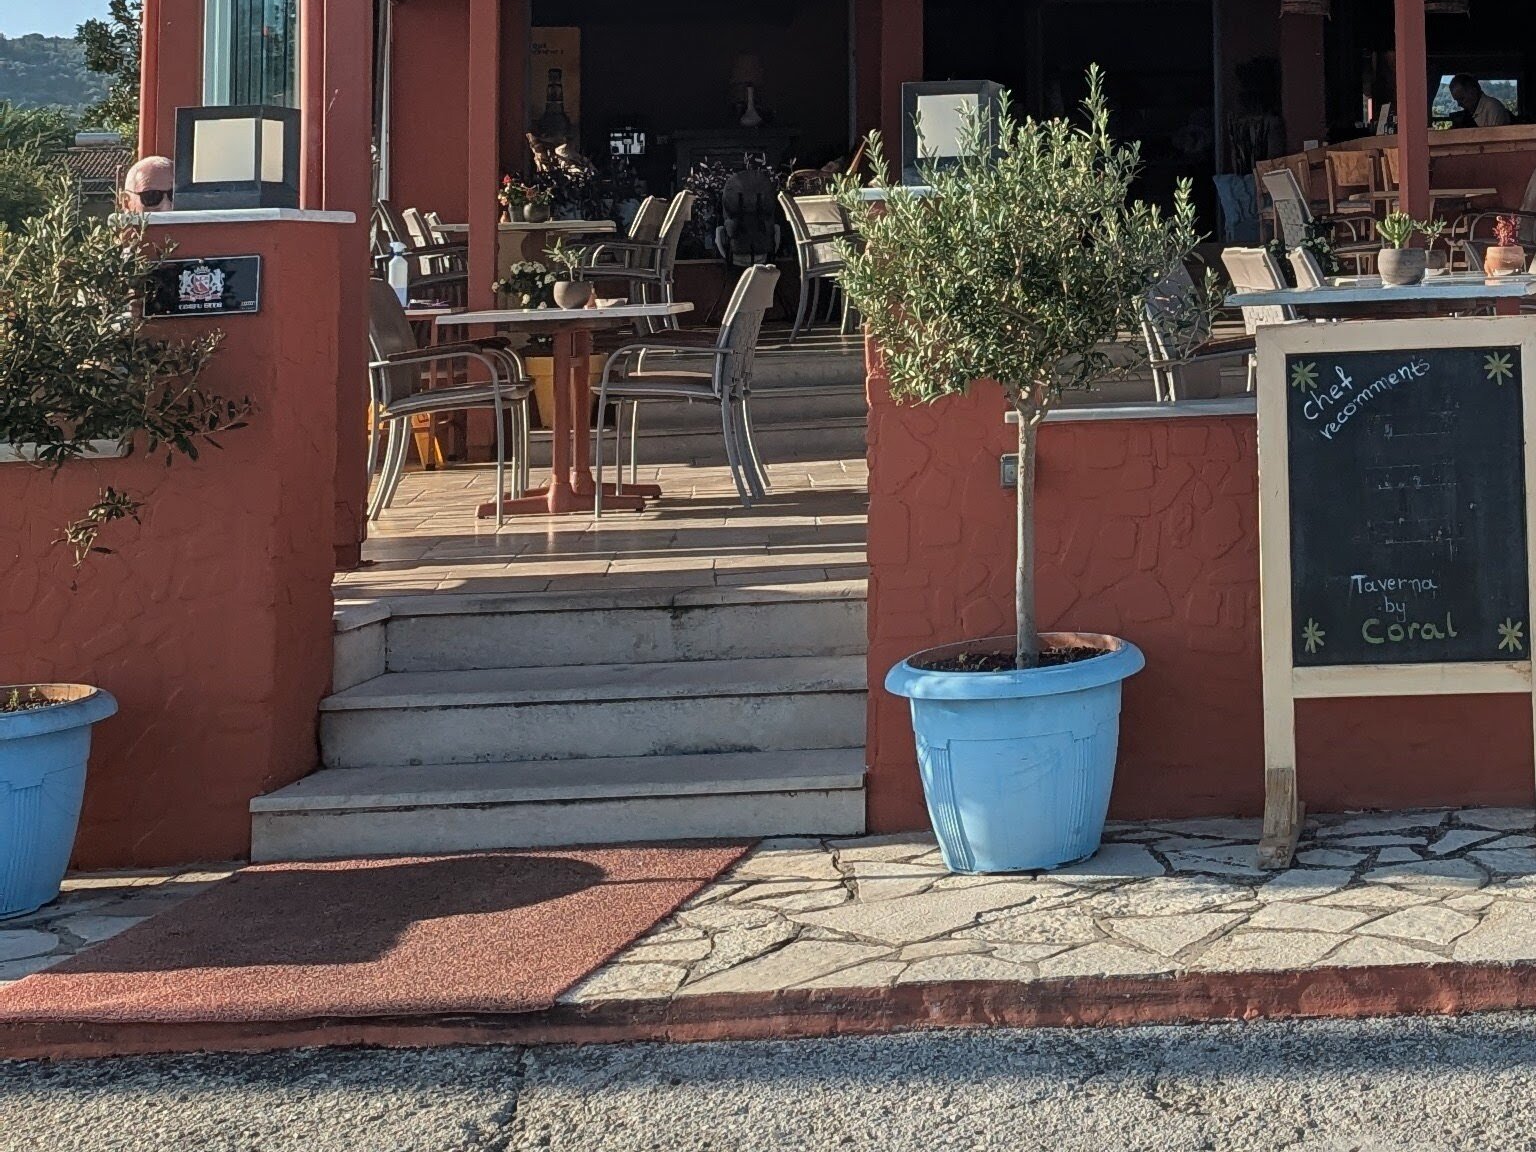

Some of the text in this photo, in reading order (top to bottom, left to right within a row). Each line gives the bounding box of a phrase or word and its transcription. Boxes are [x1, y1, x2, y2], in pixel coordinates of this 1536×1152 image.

[1303, 366, 1353, 421] Chef
[1319, 358, 1431, 440] recomments
[1350, 574, 1439, 594] Taverna
[1384, 596, 1406, 622] by
[1361, 612, 1458, 643] Coral
